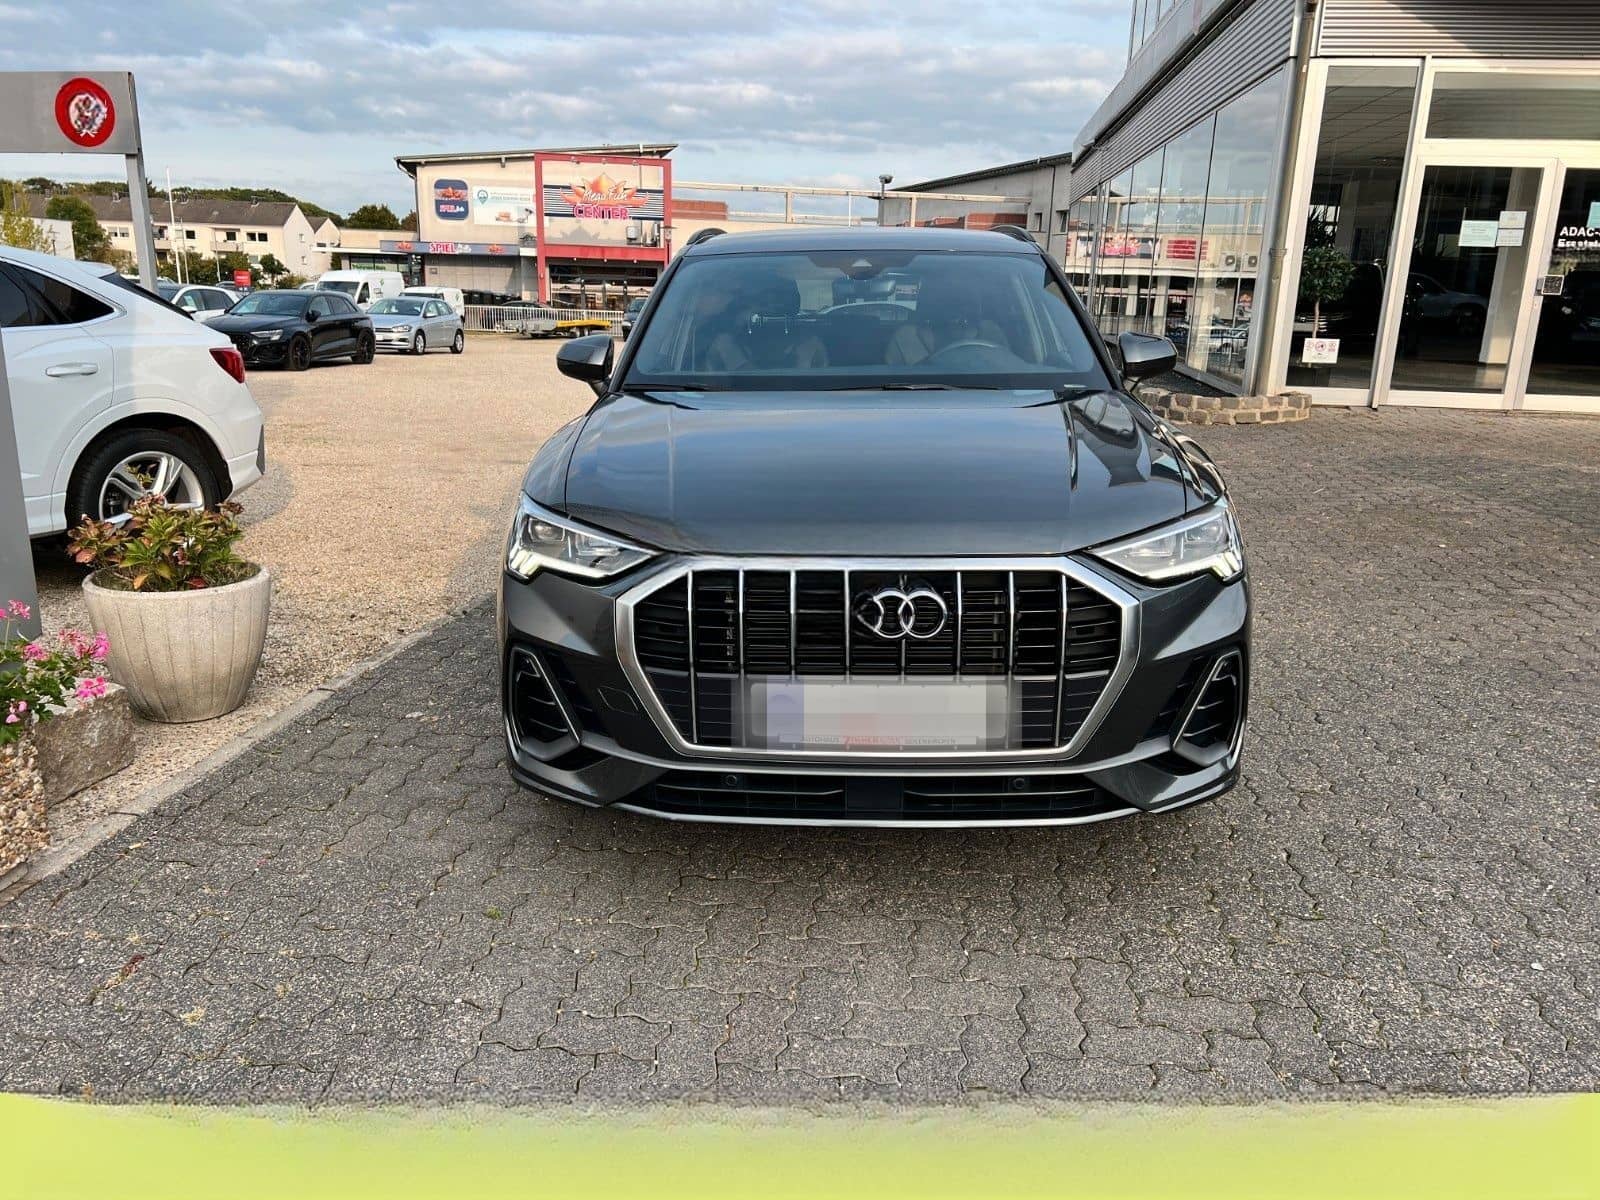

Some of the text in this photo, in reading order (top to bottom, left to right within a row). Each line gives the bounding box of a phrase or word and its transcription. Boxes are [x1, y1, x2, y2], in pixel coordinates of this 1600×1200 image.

[573, 205, 630, 220] CENTER
[1559, 226, 1600, 237] ADAC-
[429, 242, 457, 254] SPIEL
